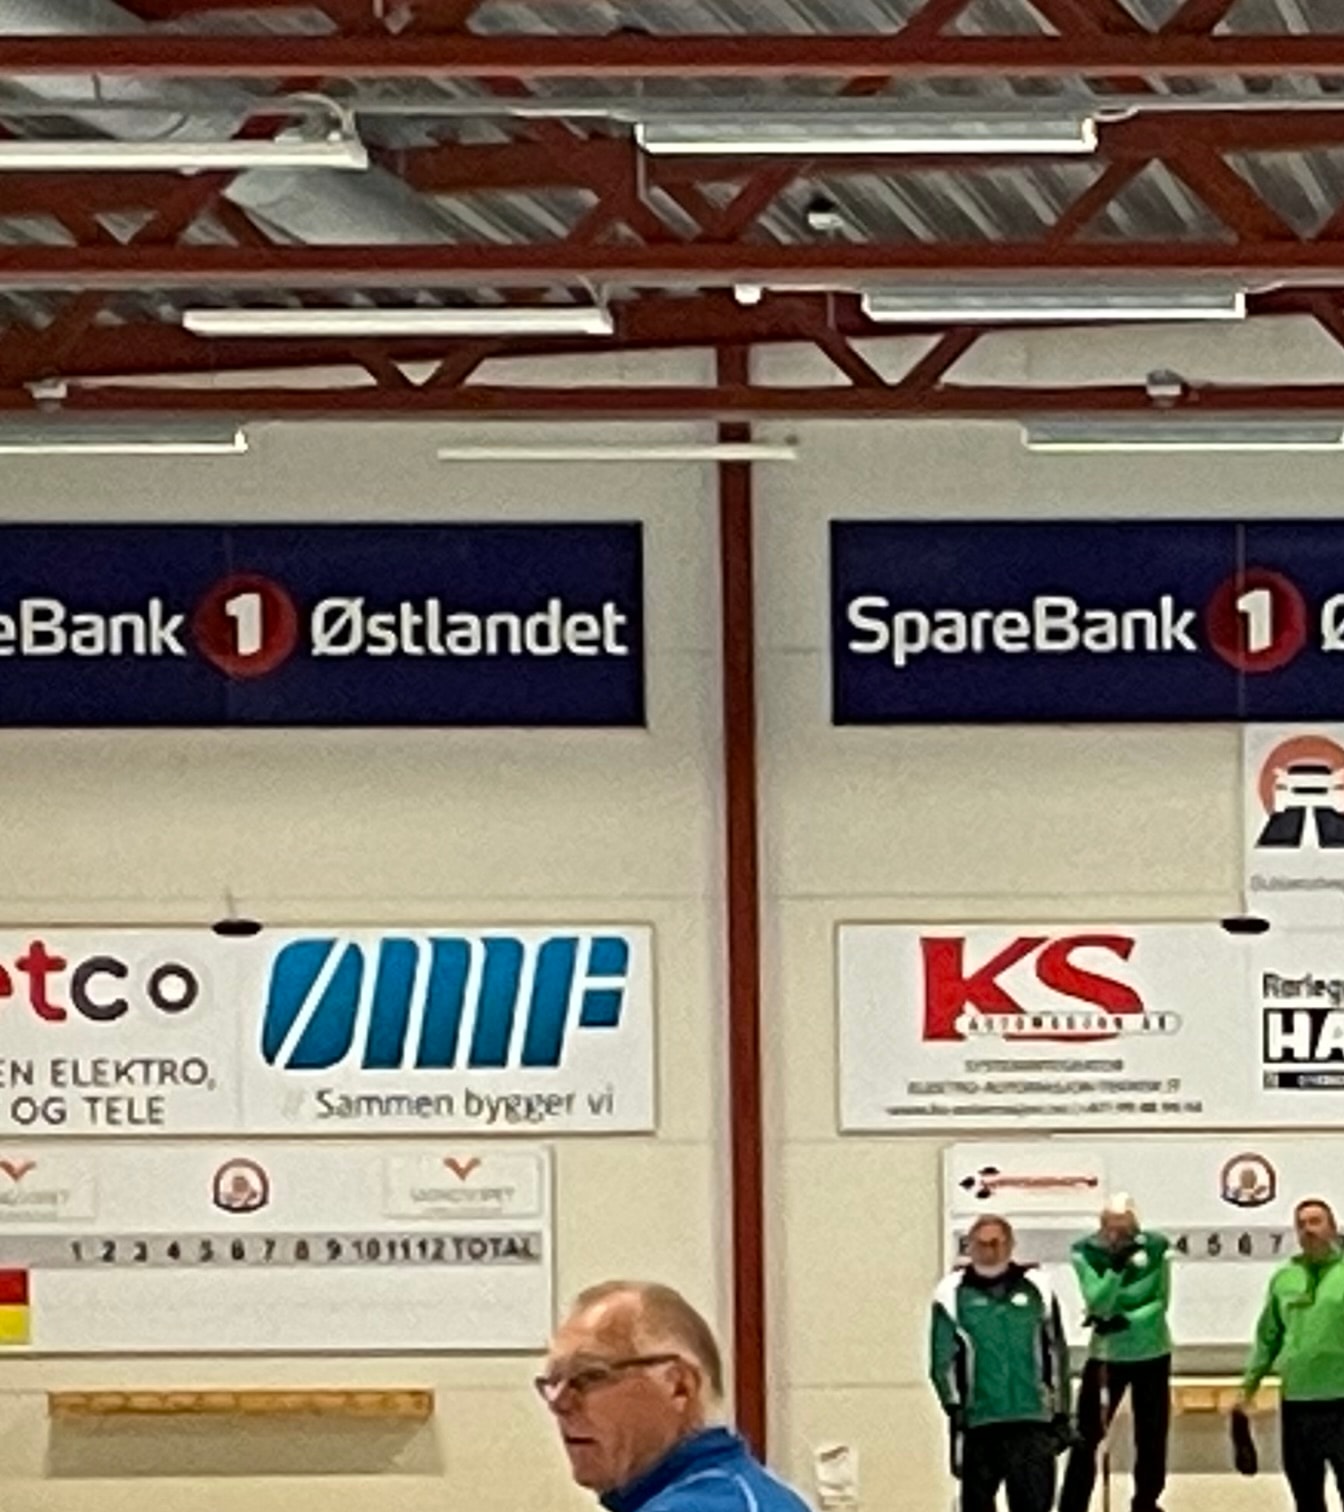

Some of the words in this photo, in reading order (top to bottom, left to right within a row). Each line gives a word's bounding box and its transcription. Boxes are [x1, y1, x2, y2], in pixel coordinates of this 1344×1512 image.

[225, 593, 262, 656] 1
[311, 597, 629, 656] Østlandet
[847, 595, 1197, 667] SpareBank
[1236, 589, 1272, 653] 1
[919, 934, 1145, 1042] KS
[51, 1056, 217, 1092] ELEKTRO,
[10, 1095, 67, 1126] OG
[84, 1095, 165, 1126] TELE
[315, 1088, 455, 1119] Sammen
[586, 1085, 615, 1116] vi
[101, 1240, 116, 1262] 2
[134, 1240, 148, 1262] 3
[167, 1240, 181, 1260] 4
[264, 1239, 276, 1262] 7
[326, 1238, 341, 1261] 9
[352, 1237, 381, 1261] 10
[387, 1237, 410, 1260] 11
[418, 1237, 445, 1261] 12
[452, 1236, 535, 1260] TOTAL
[1207, 1233, 1222, 1256] 5
[1270, 1234, 1284, 1256] 7
